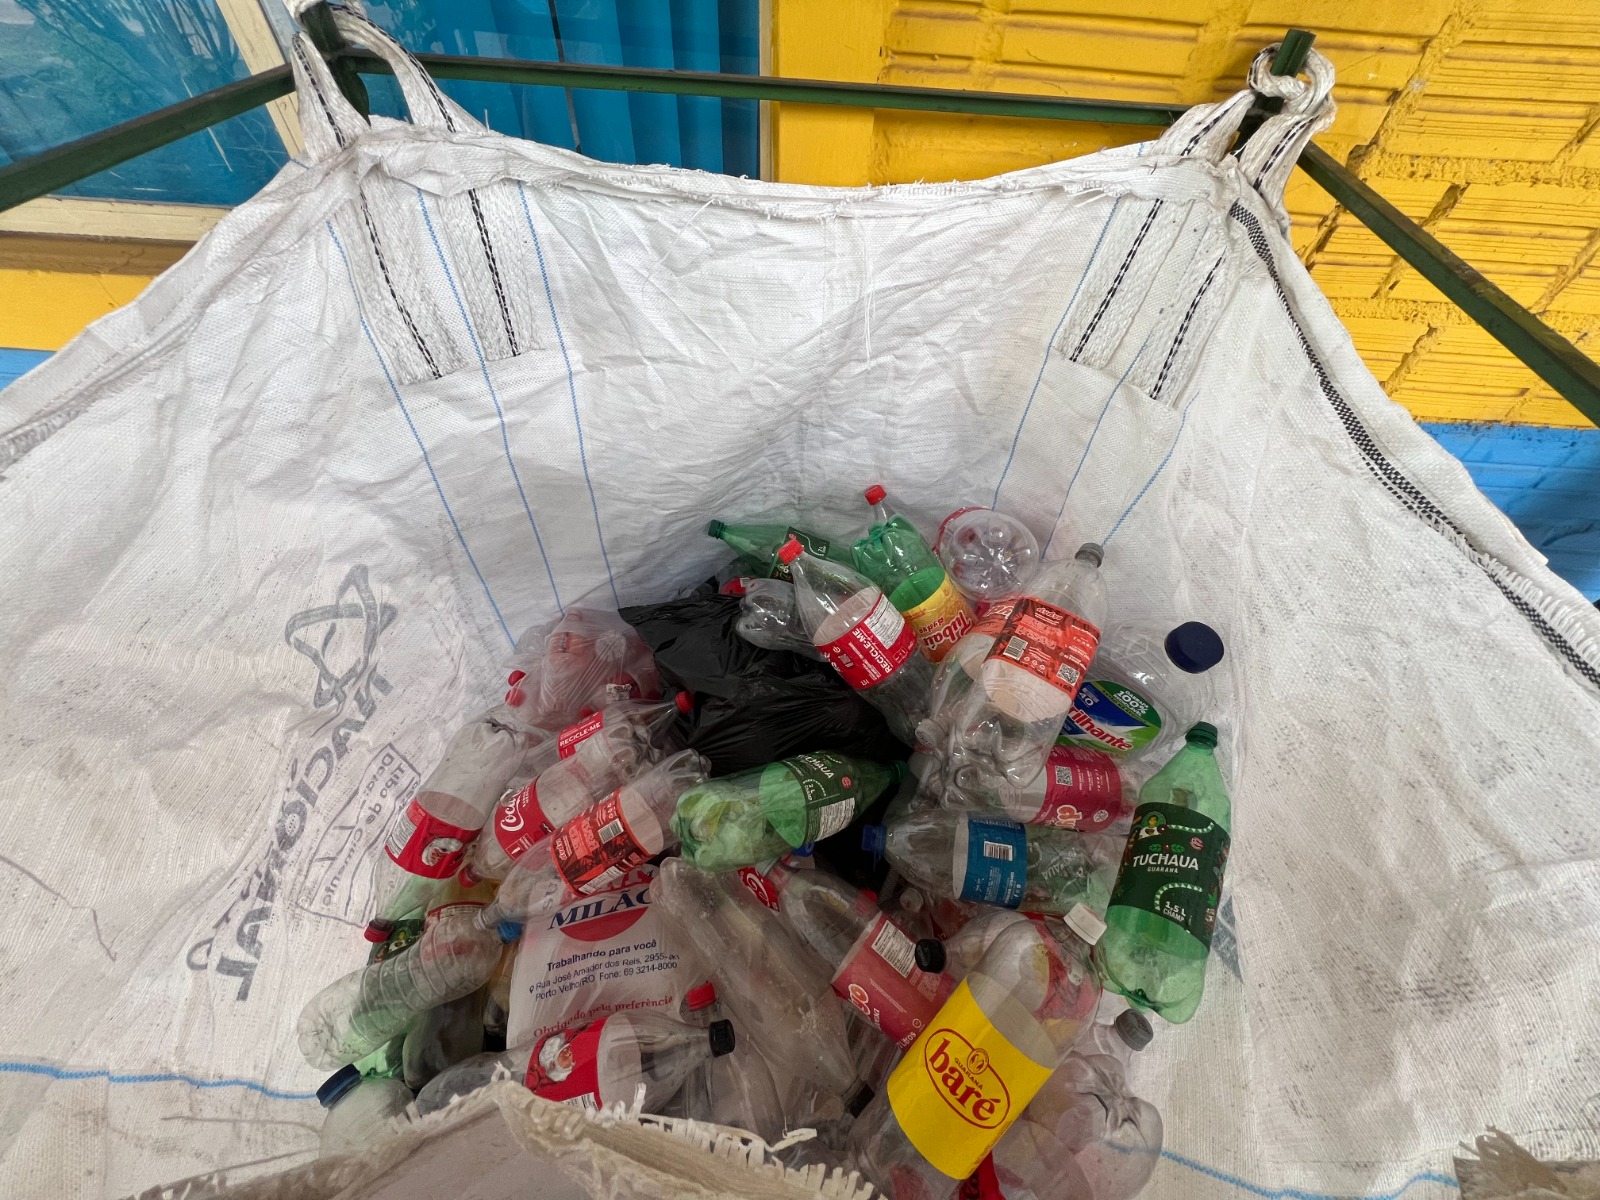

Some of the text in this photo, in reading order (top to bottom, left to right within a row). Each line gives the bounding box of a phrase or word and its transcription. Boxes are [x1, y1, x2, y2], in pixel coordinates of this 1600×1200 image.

[922, 610, 973, 651] Tubaú
[852, 628, 892, 674] RECICLE-ME
[1117, 690, 1149, 715] 100%
[559, 721, 601, 747] RECICLE-ME
[1066, 704, 1134, 751] rilhante
[1132, 853, 1199, 871] TUCHAUA
[1162, 908, 1185, 922] CHAMP
[547, 939, 657, 972] Trabalhando para você
[535, 961, 678, 1001] Porto Velho/RO Fone: 69 3214-8000
[553, 972, 572, 984] José
[573, 964, 603, 978] Amador
[604, 960, 620, 969] dos
[615, 995, 673, 1012] preferência
[929, 1037, 1001, 1121] baré
[954, 1058, 983, 1090] GUARANÁ
